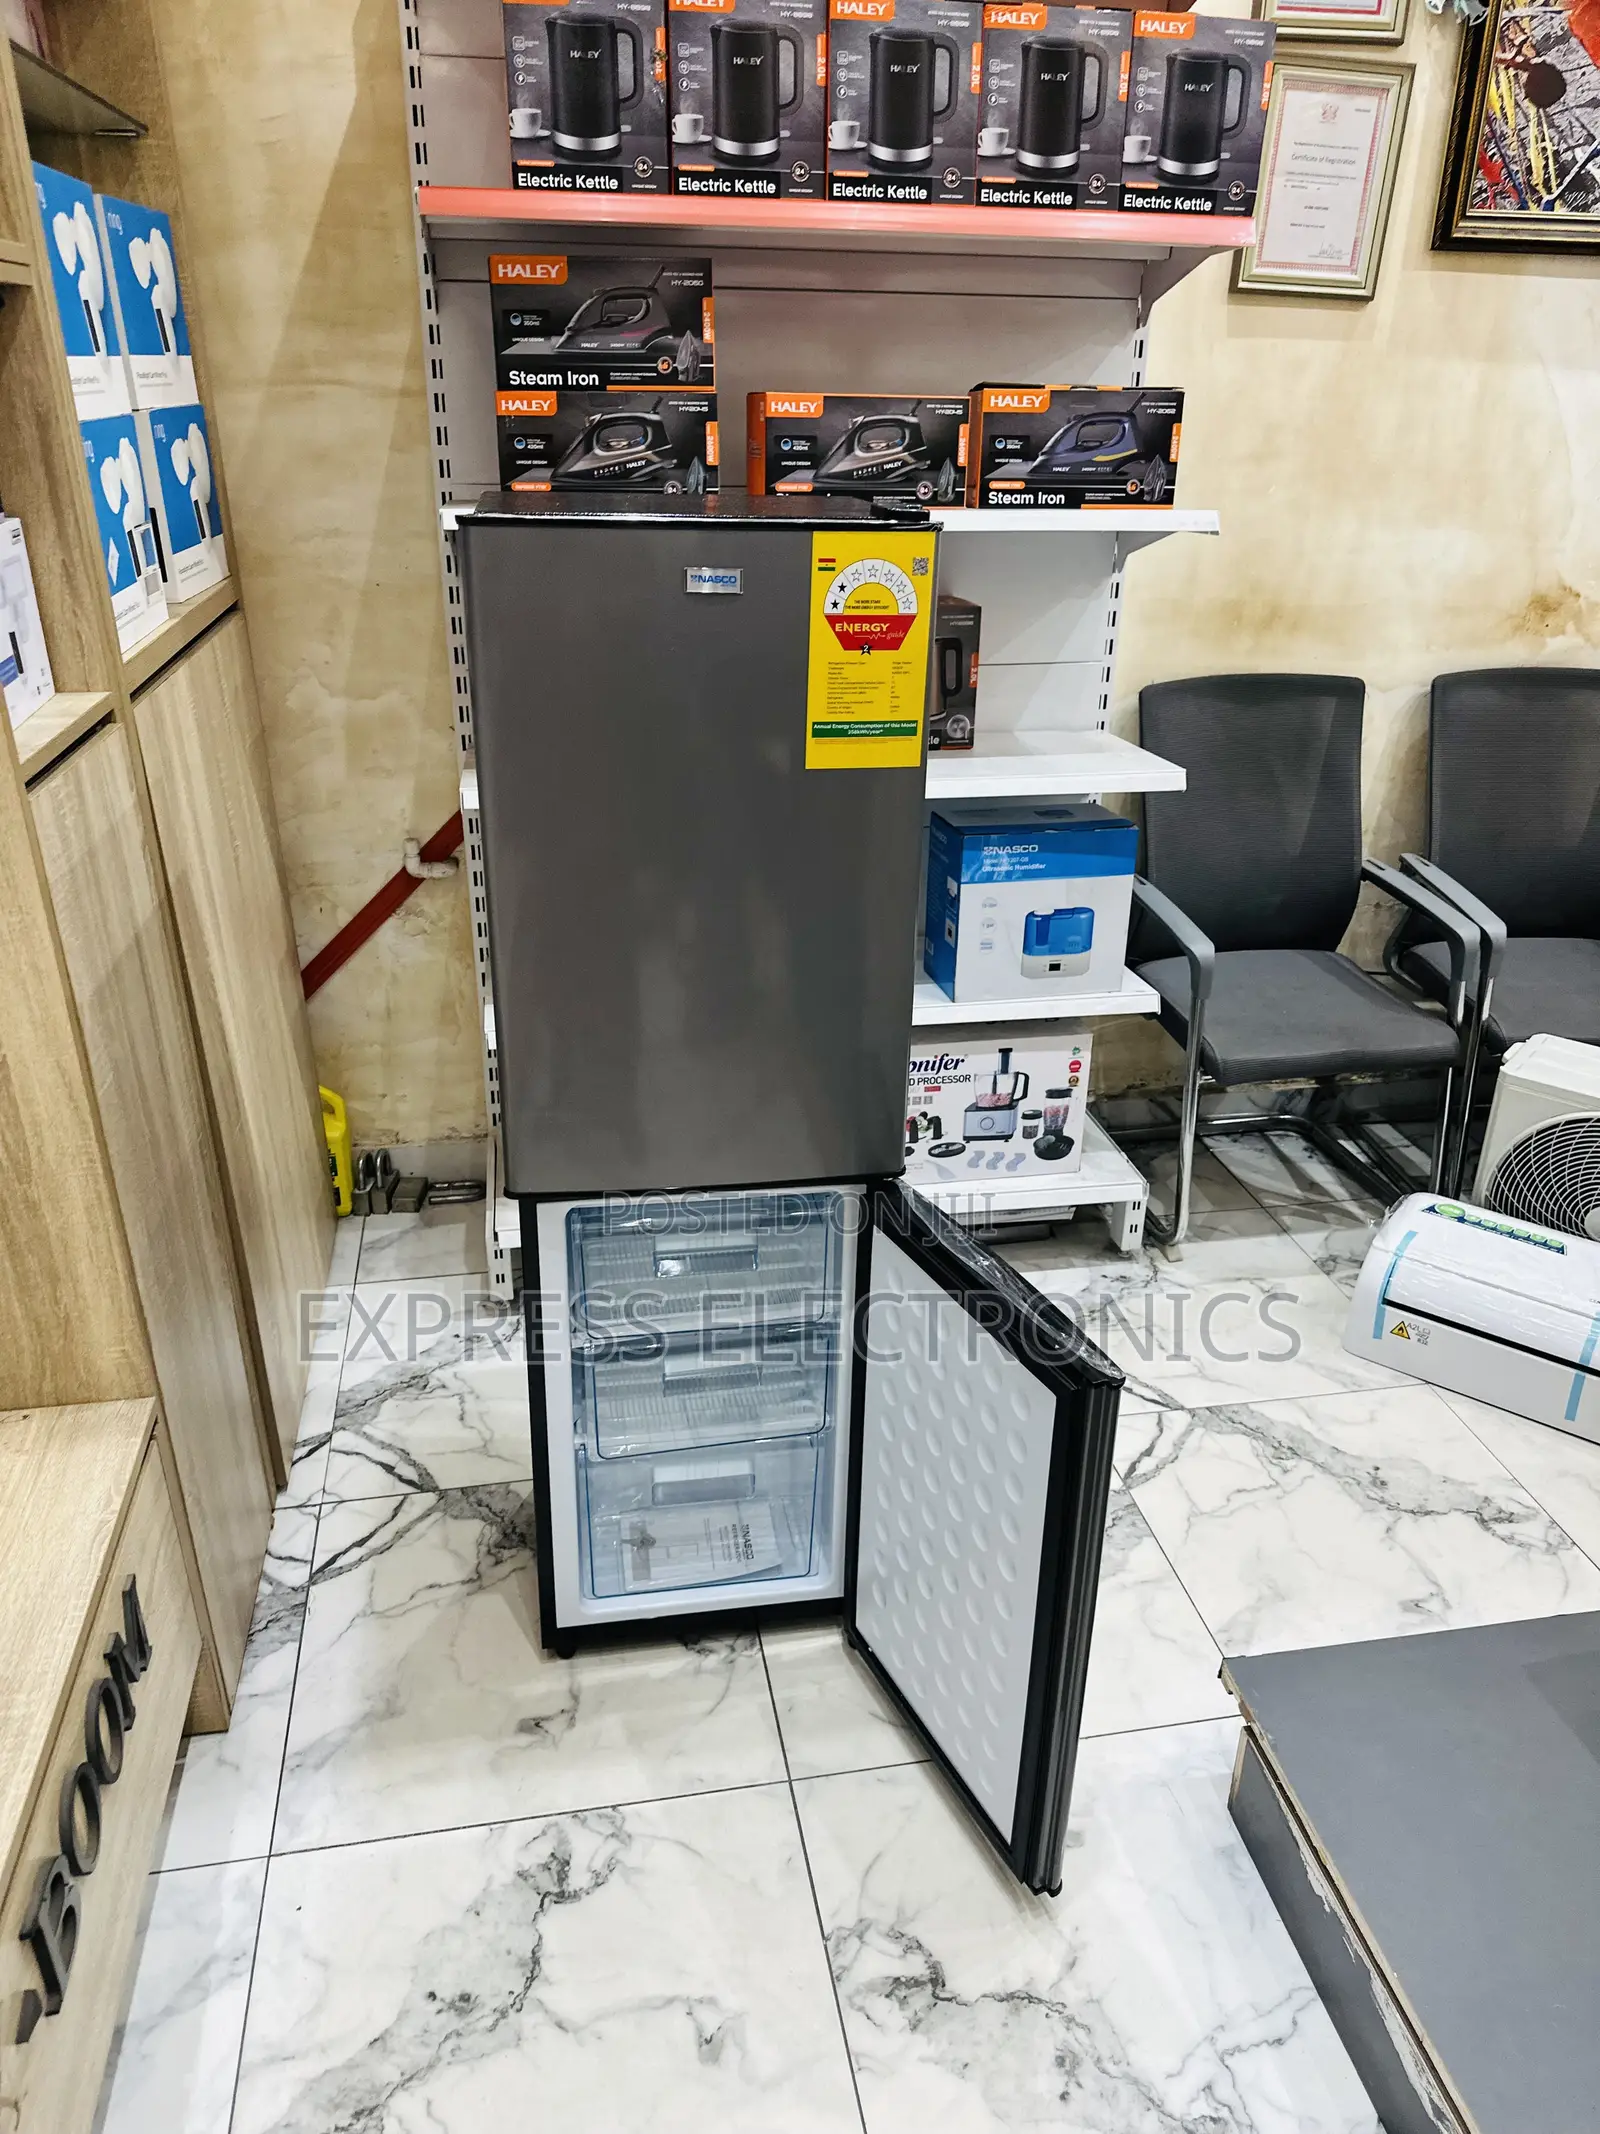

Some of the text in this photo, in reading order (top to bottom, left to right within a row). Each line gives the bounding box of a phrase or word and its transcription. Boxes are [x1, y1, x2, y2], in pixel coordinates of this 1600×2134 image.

[837, 2, 886, 16] HALEY
[990, 12, 1039, 26] HALEY
[1140, 19, 1188, 35] HALEY
[517, 172, 619, 190] Electric Kettle
[678, 177, 776, 194] Electric Kettle
[833, 183, 928, 200] Electric Kettle
[980, 189, 1073, 206] Electric Kettle
[1123, 194, 1213, 212] Electric Kettle
[498, 263, 560, 279] HALEY
[509, 370, 563, 386] Steam
[567, 370, 599, 386] Iron
[501, 399, 550, 412] HALEY
[771, 401, 816, 414] HALEY
[990, 395, 1043, 408] HALEY
[988, 491, 1065, 505] Steam Iron
[698, 574, 737, 584] NASCO
[835, 621, 890, 635] ENERGY
[863, 644, 869, 652] 2
[850, 722, 884, 730] Consumption
[994, 844, 1039, 854] NASCO
[1014, 863, 1046, 871] Humidifier
[917, 1074, 972, 1086] PROCESSOR
